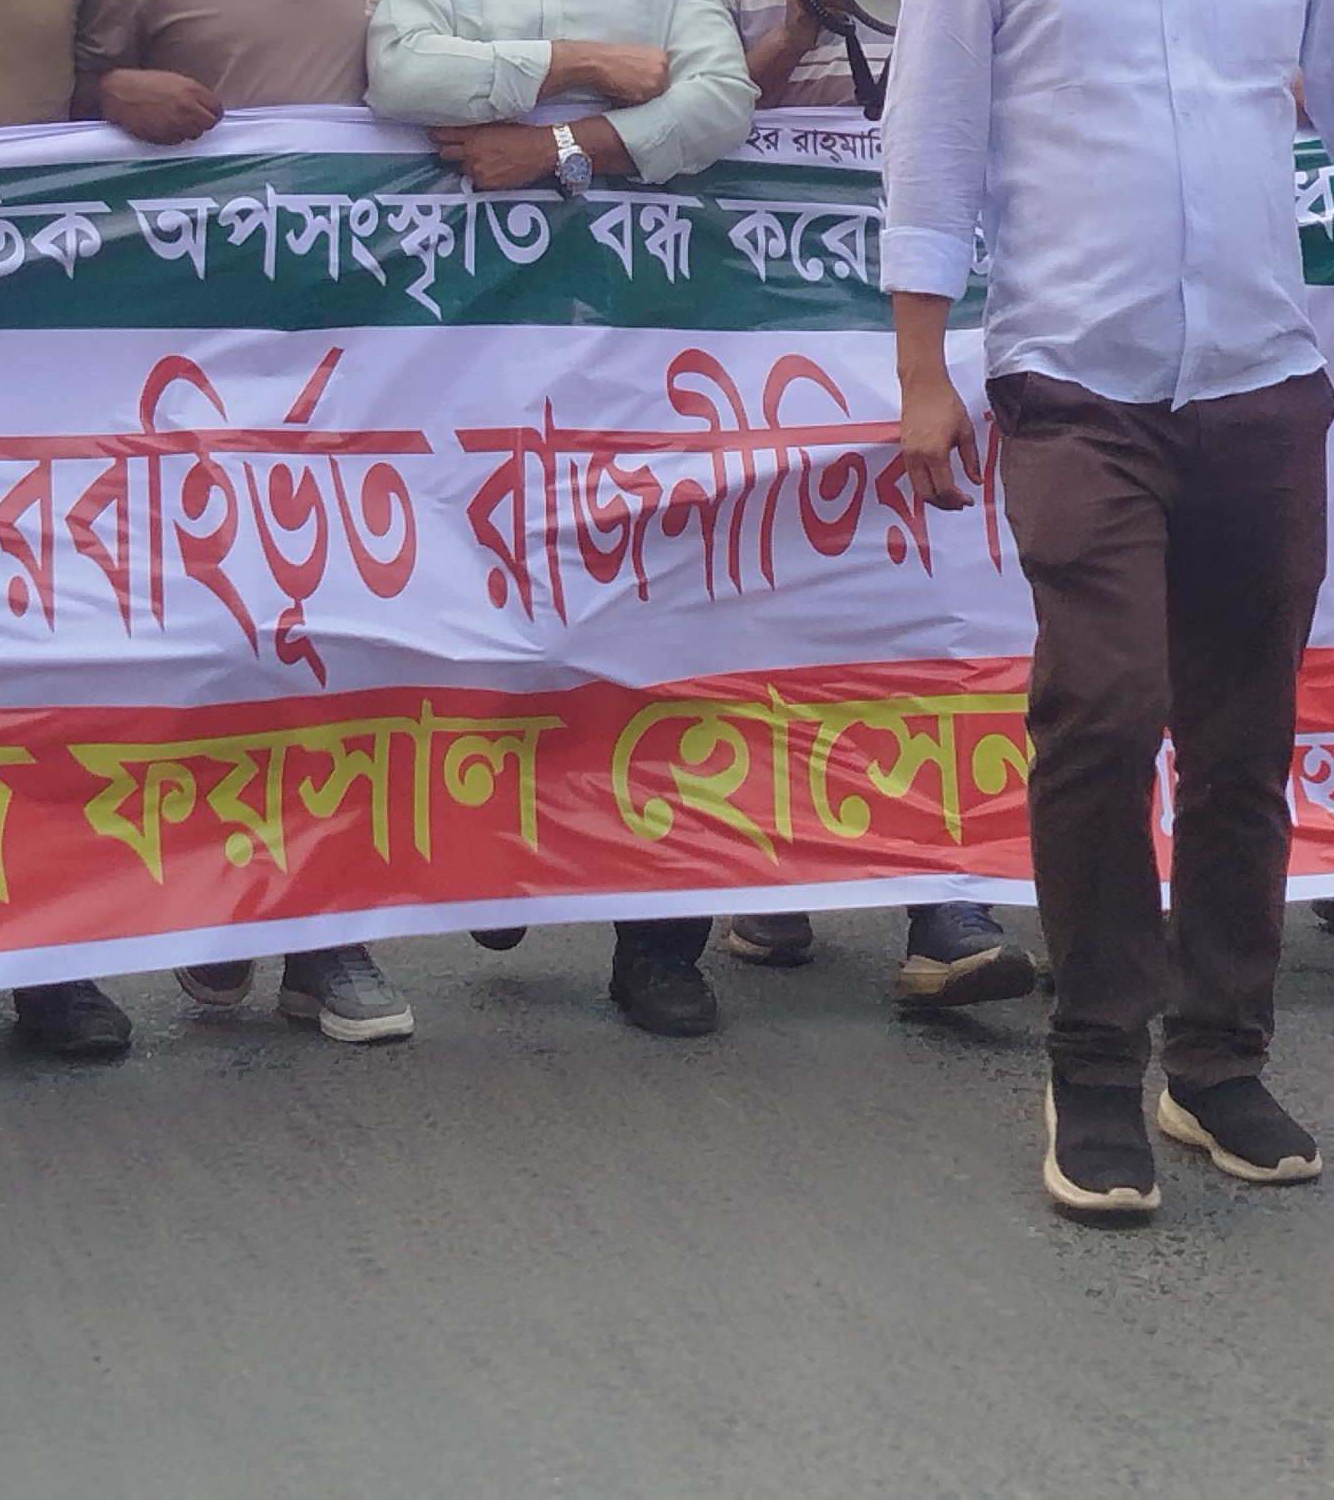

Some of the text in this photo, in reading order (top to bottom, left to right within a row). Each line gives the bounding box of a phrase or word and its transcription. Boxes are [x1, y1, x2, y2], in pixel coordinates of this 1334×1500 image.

[584, 189, 704, 284] বন্ধ
[455, 346, 932, 628] রাজনীতির
[67, 697, 565, 884] ফয়সাল
[610, 681, 1036, 866] হোসেন
